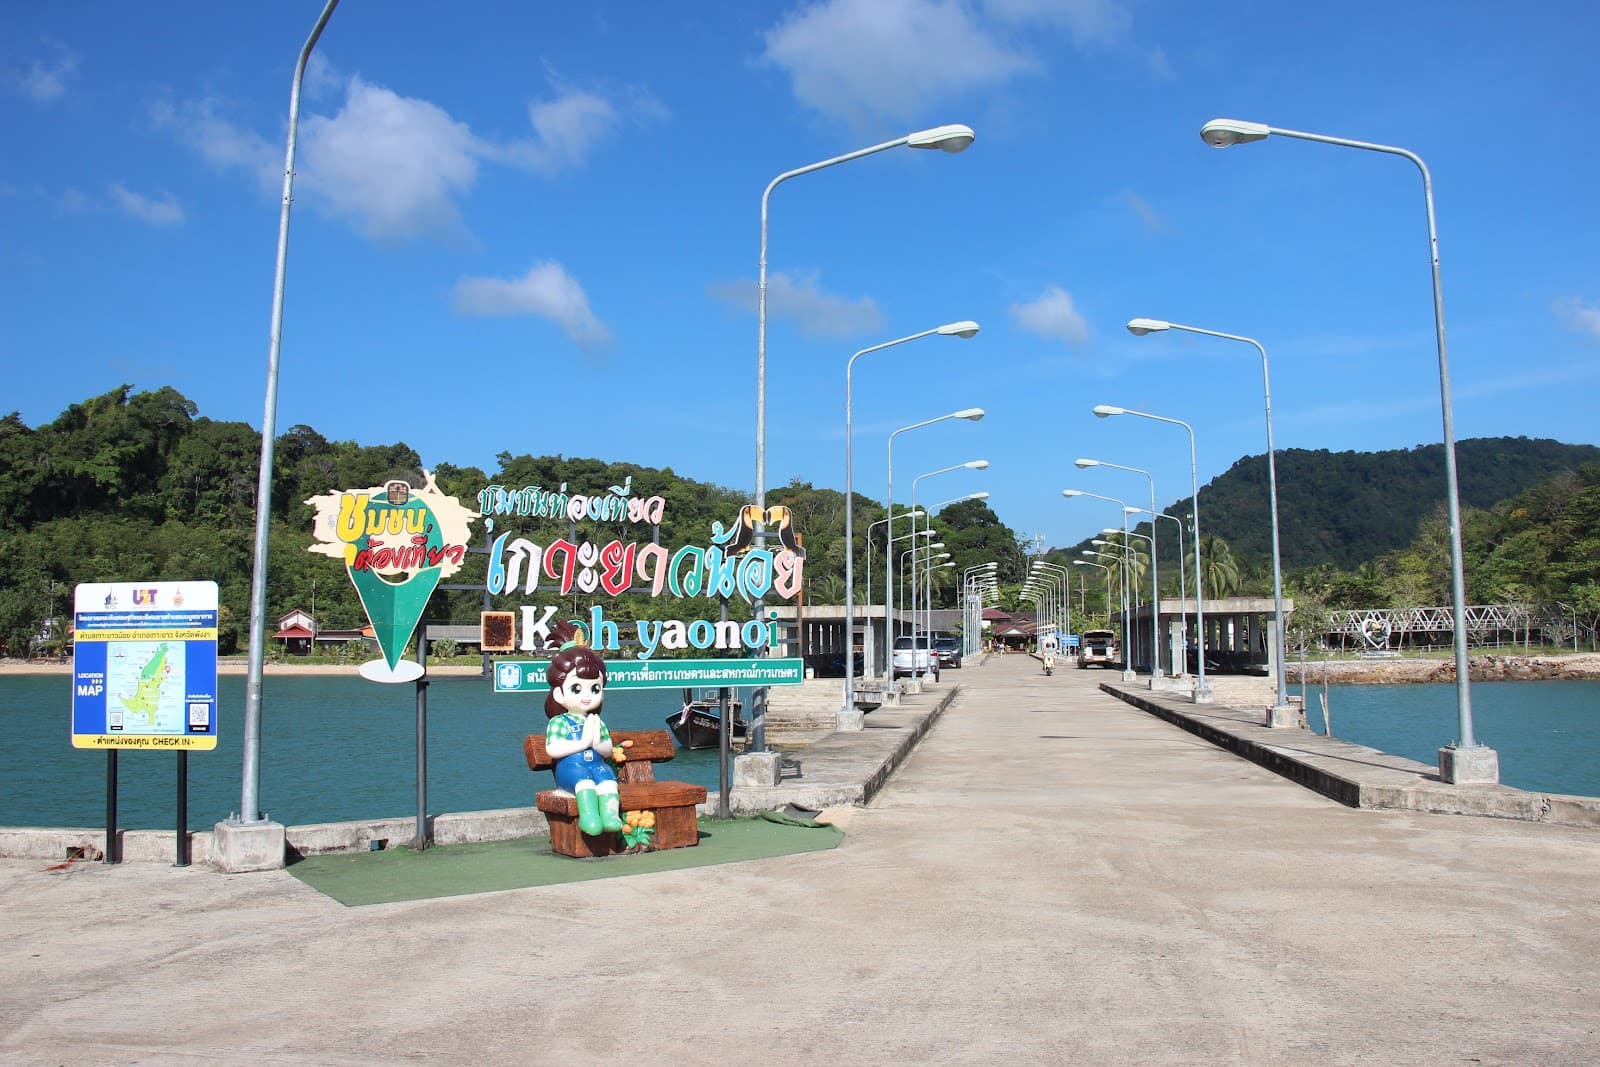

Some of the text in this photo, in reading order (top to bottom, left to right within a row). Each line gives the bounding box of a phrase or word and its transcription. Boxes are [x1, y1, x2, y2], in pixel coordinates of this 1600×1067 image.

[336, 493, 427, 566] ชุมชน
[477, 475, 666, 534] ชุมชนท่องเที่ยว
[354, 523, 465, 573] ต้องเที่ยว
[486, 520, 804, 605] เกาะยาวน้อย
[635, 610, 779, 660] yaonoi
[77, 685, 104, 697] MAP
[605, 662, 798, 682] นาคารเพื่อการเกษตรและสหกรณ์การเกษตร
[152, 737, 179, 746] CHECK
